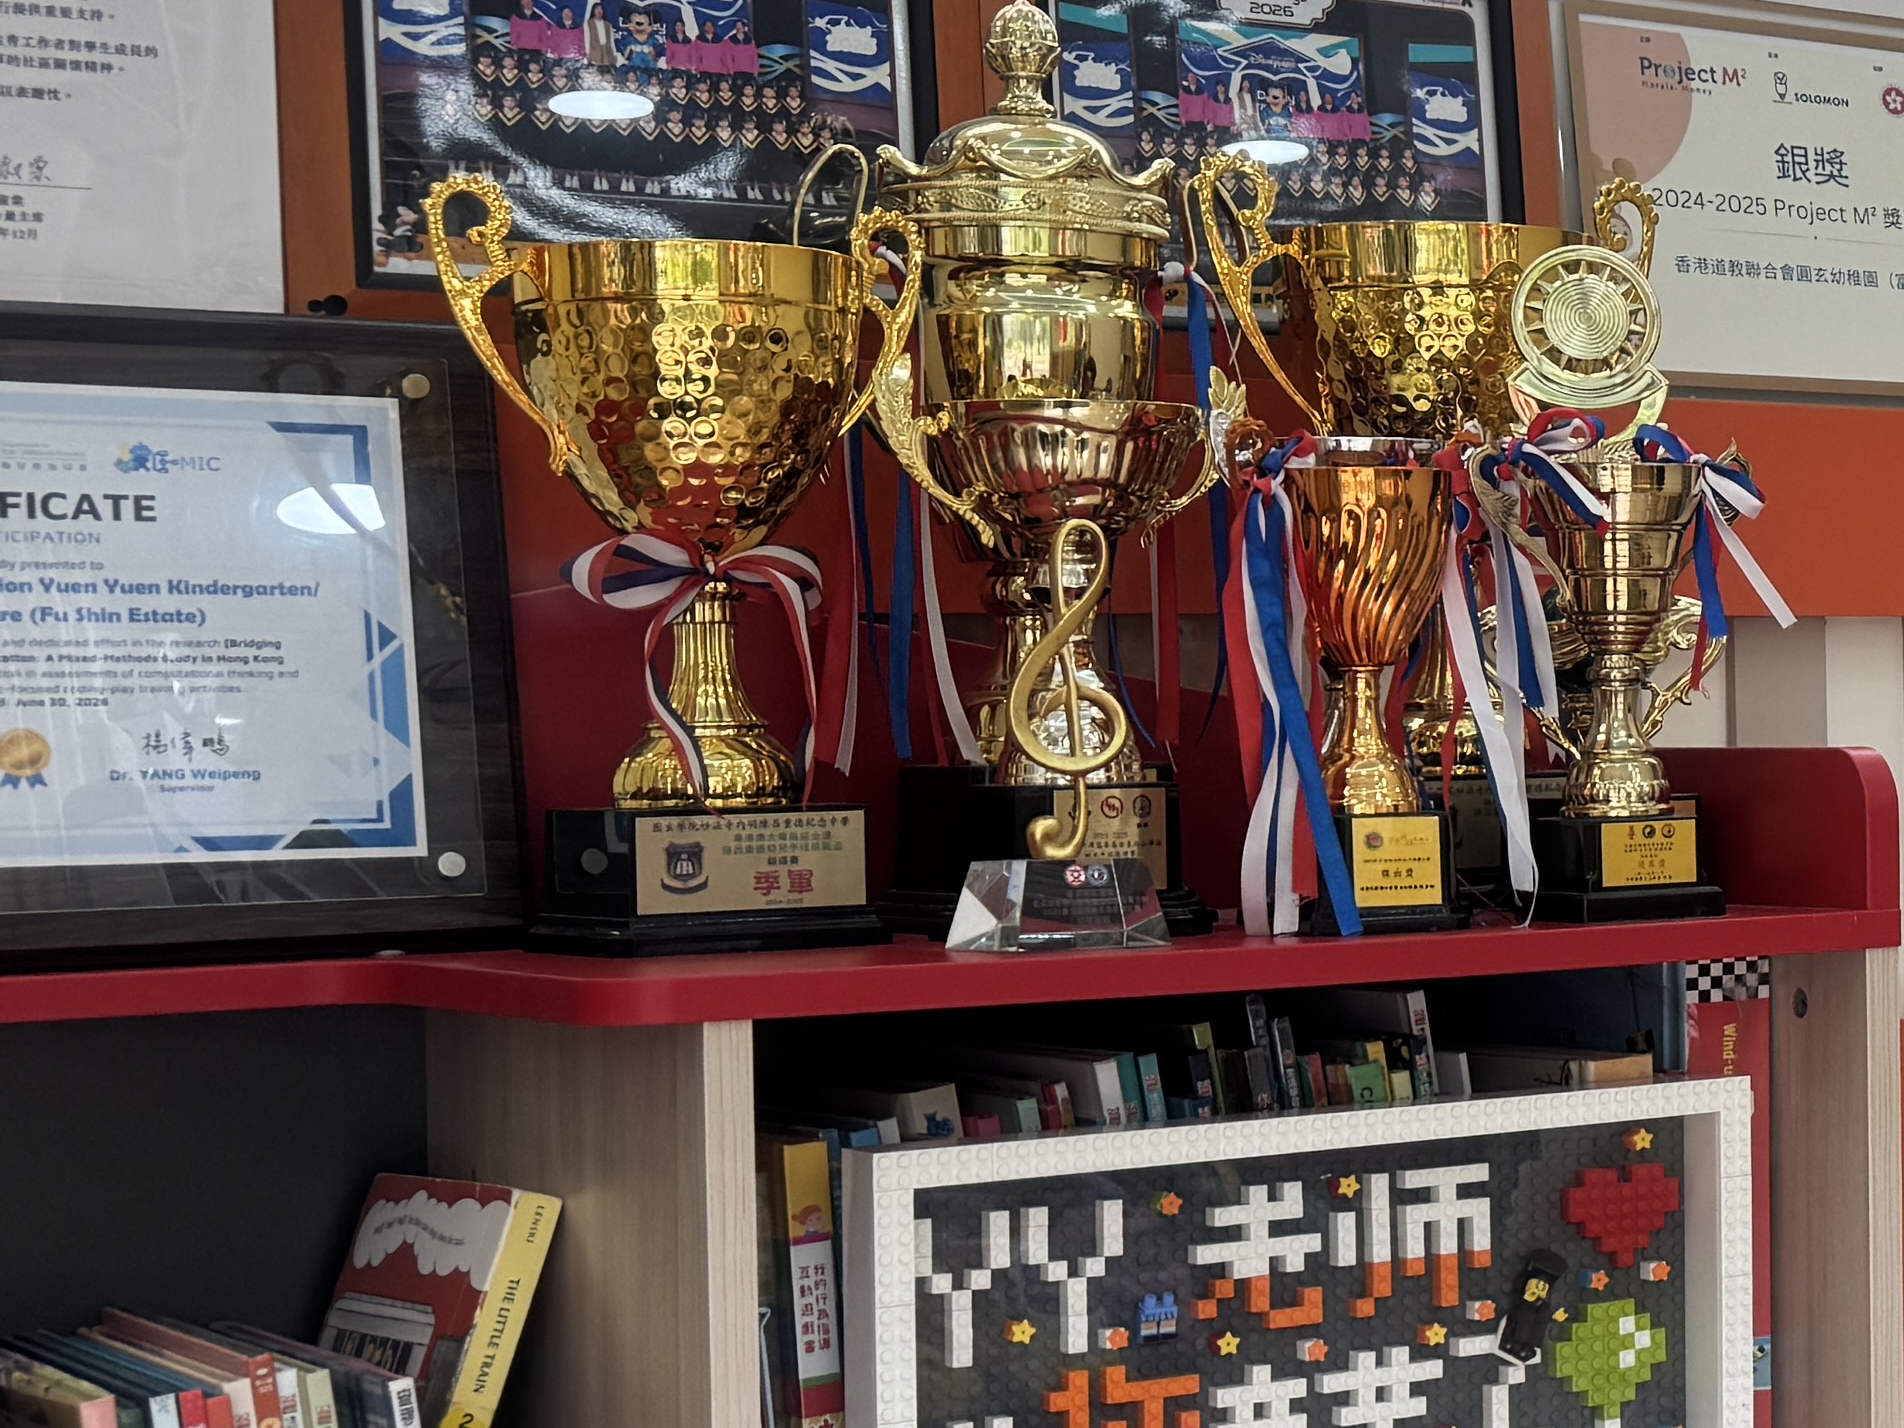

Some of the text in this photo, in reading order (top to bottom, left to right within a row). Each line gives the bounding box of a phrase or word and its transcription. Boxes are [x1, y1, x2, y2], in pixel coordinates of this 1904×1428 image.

[1249, 1, 1295, 18] 2026
[1639, 56, 1718, 86] Project
[1794, 92, 1850, 108] SOLOMON
[1773, 142, 1851, 188] 銀獎
[1650, 186, 1768, 217] 2024-2025
[1773, 197, 1848, 227] Project
[39, 577, 98, 595] Yuen
[103, 578, 161, 595] Yuen
[75, 607, 123, 624] Shin
[128, 607, 206, 628] Estate)
[753, 868, 814, 897] 季軍
[473, 1277, 520, 1394] THE LITTLE TRAIN
